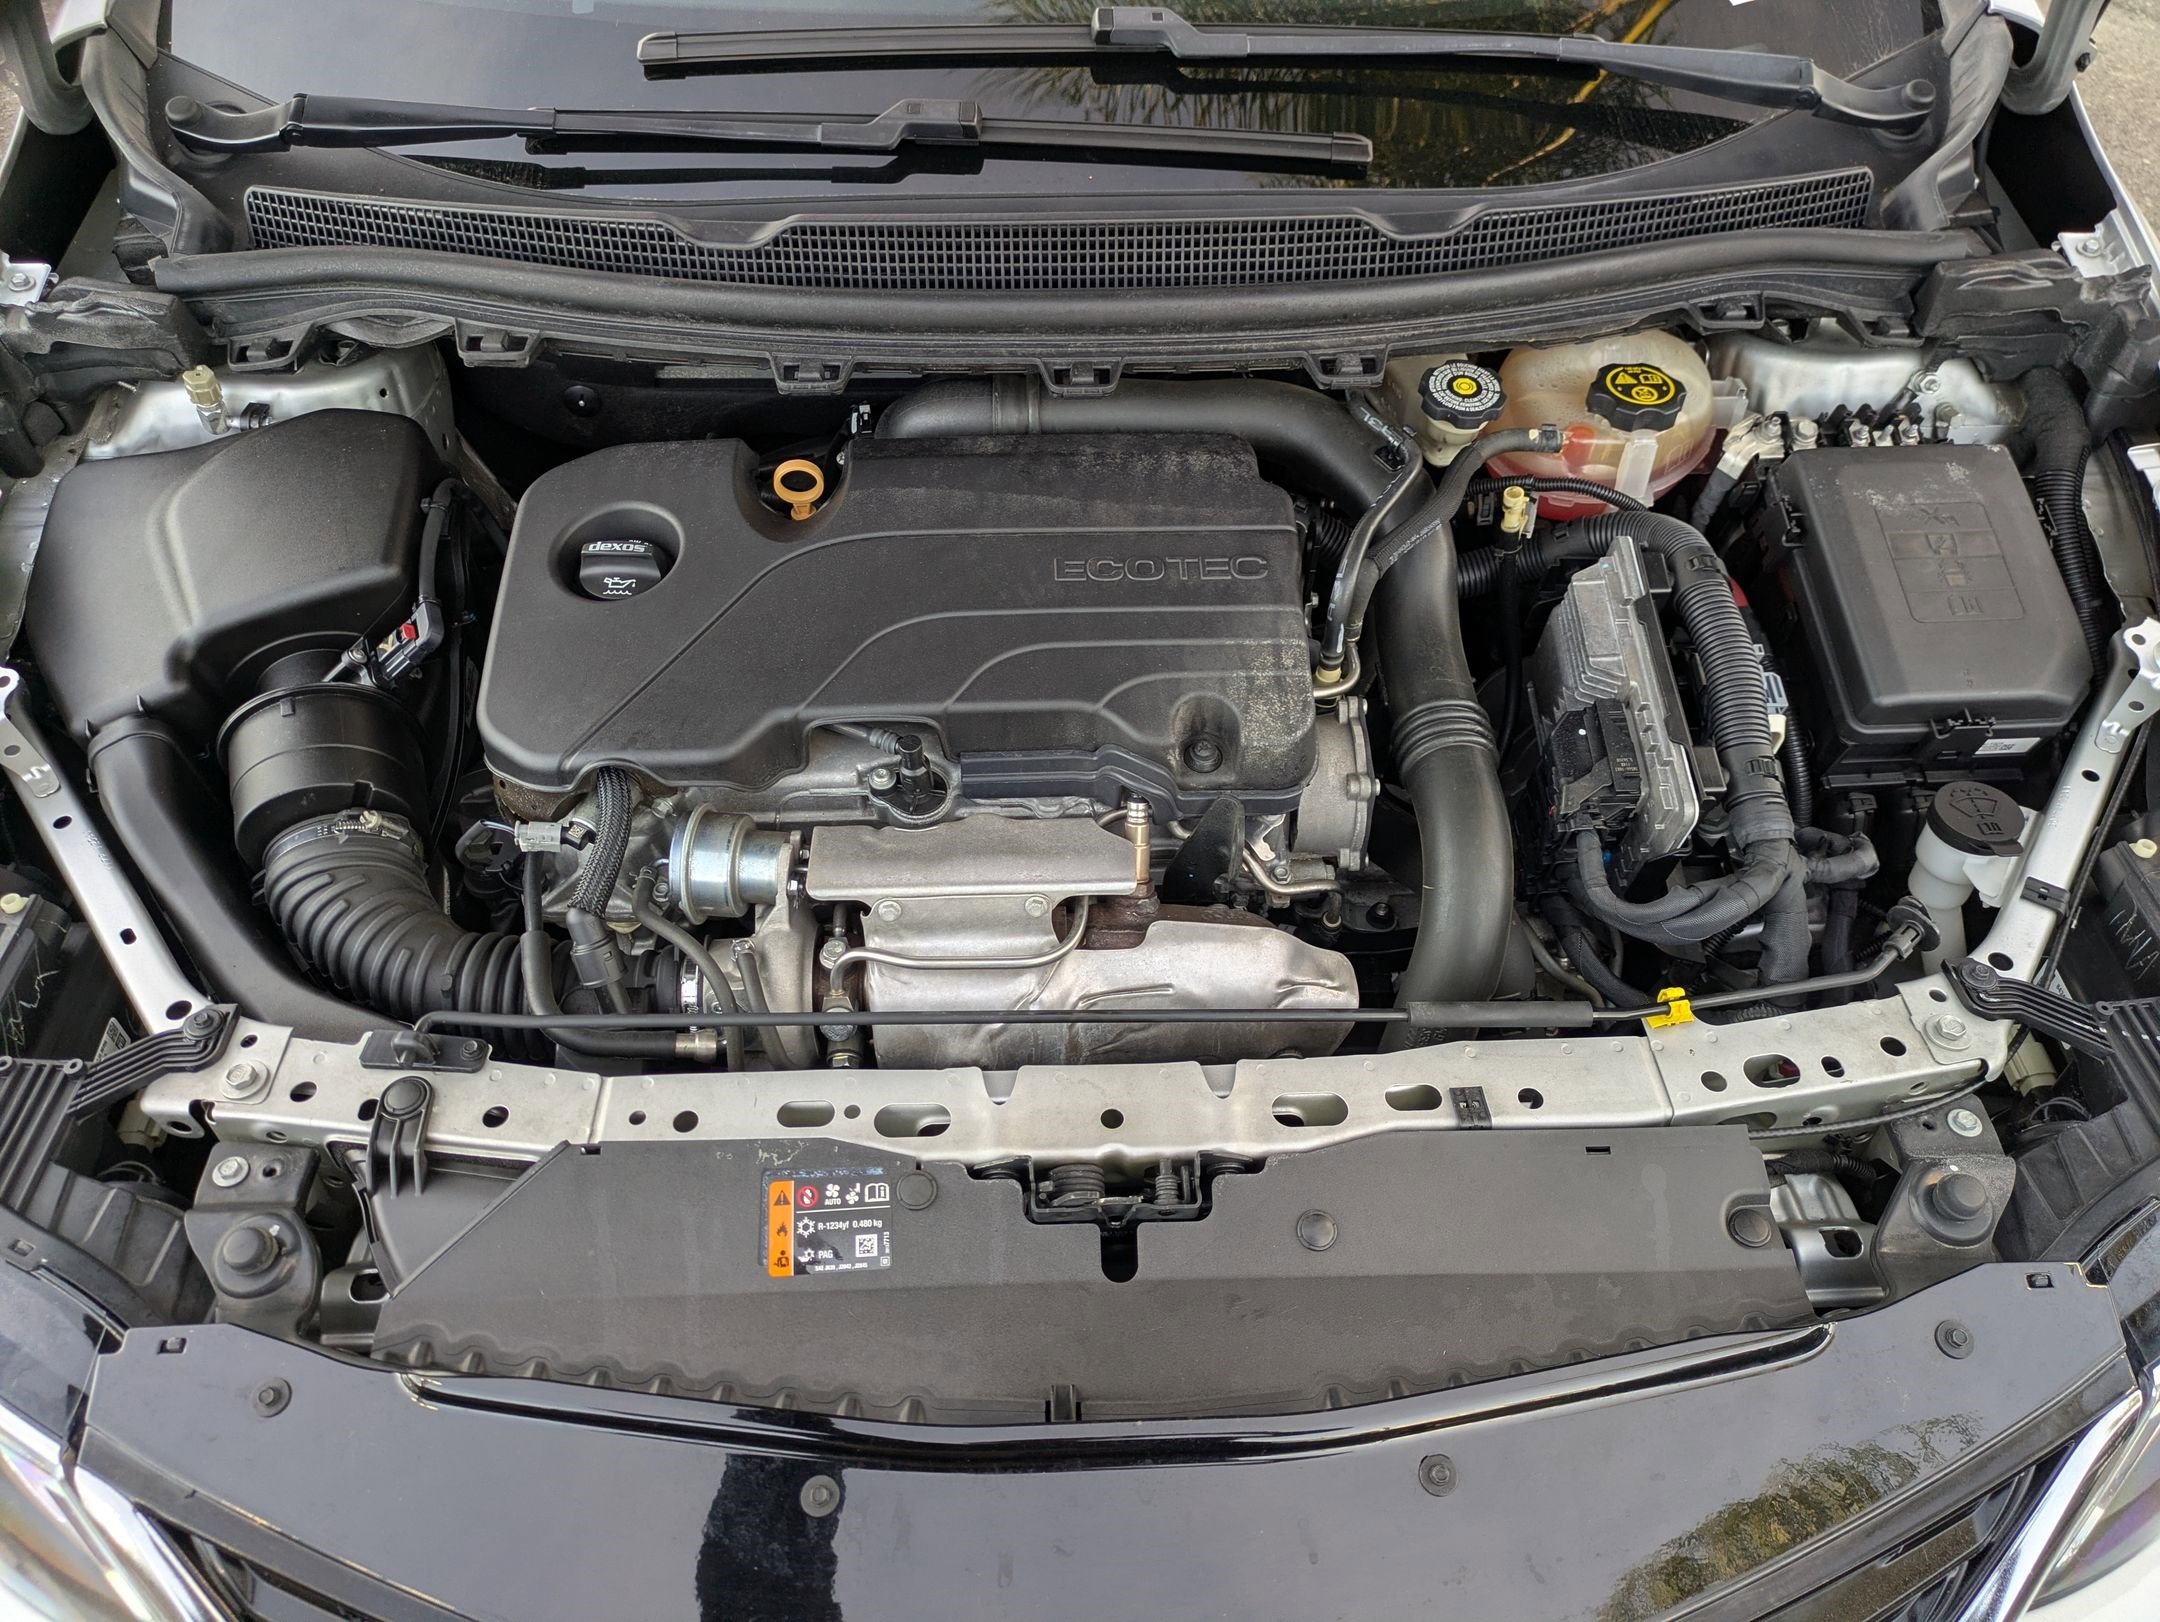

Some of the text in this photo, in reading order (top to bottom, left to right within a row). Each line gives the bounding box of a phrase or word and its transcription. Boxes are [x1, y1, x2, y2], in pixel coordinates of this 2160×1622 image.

[588, 541, 646, 552] dexos
[1053, 555, 1268, 582] ECOTEC
[817, 1219, 883, 1231] R-1234yf 0.480 kg
[818, 1250, 833, 1259] PAG
